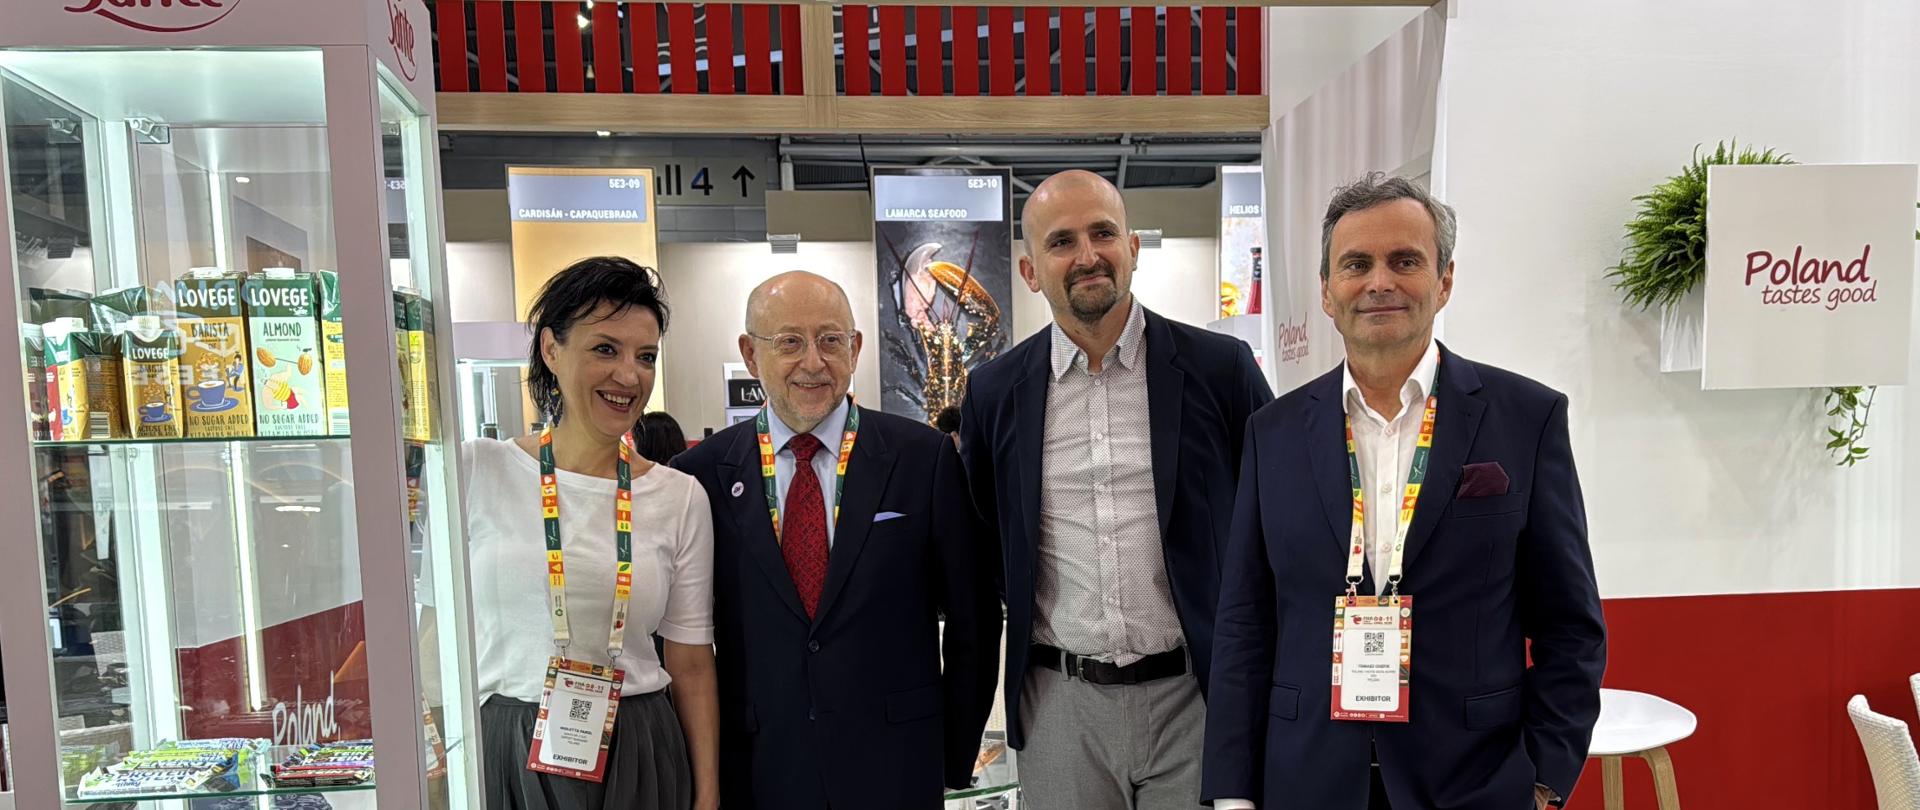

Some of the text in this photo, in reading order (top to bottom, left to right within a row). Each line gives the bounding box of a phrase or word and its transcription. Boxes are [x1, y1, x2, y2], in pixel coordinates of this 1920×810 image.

[608, 178, 641, 189] 5E3-09
[656, 164, 714, 196] ll 4
[967, 178, 998, 189] 5E3-10
[518, 207, 563, 219] CARDISÁN
[569, 209, 639, 220] CAPAQUEBRADA
[885, 208, 968, 218] LAMARCA SEAFOOD
[1229, 205, 1260, 215] HELIOS
[1744, 244, 1871, 286] Poland
[178, 287, 236, 307] LOVEGE
[250, 287, 310, 307] LOVEGE
[1761, 279, 1878, 311] tastes good
[191, 321, 230, 338] BARISTA
[262, 321, 302, 338] ALMOND
[1278, 312, 1308, 348] Poland
[131, 347, 168, 359] LOVEGE
[189, 414, 249, 426] NO SUGAR ADDED
[259, 413, 319, 425] NO SUGAR ADDED
[272, 670, 337, 748] Poland
[552, 753, 588, 765] EXHIBITOR
